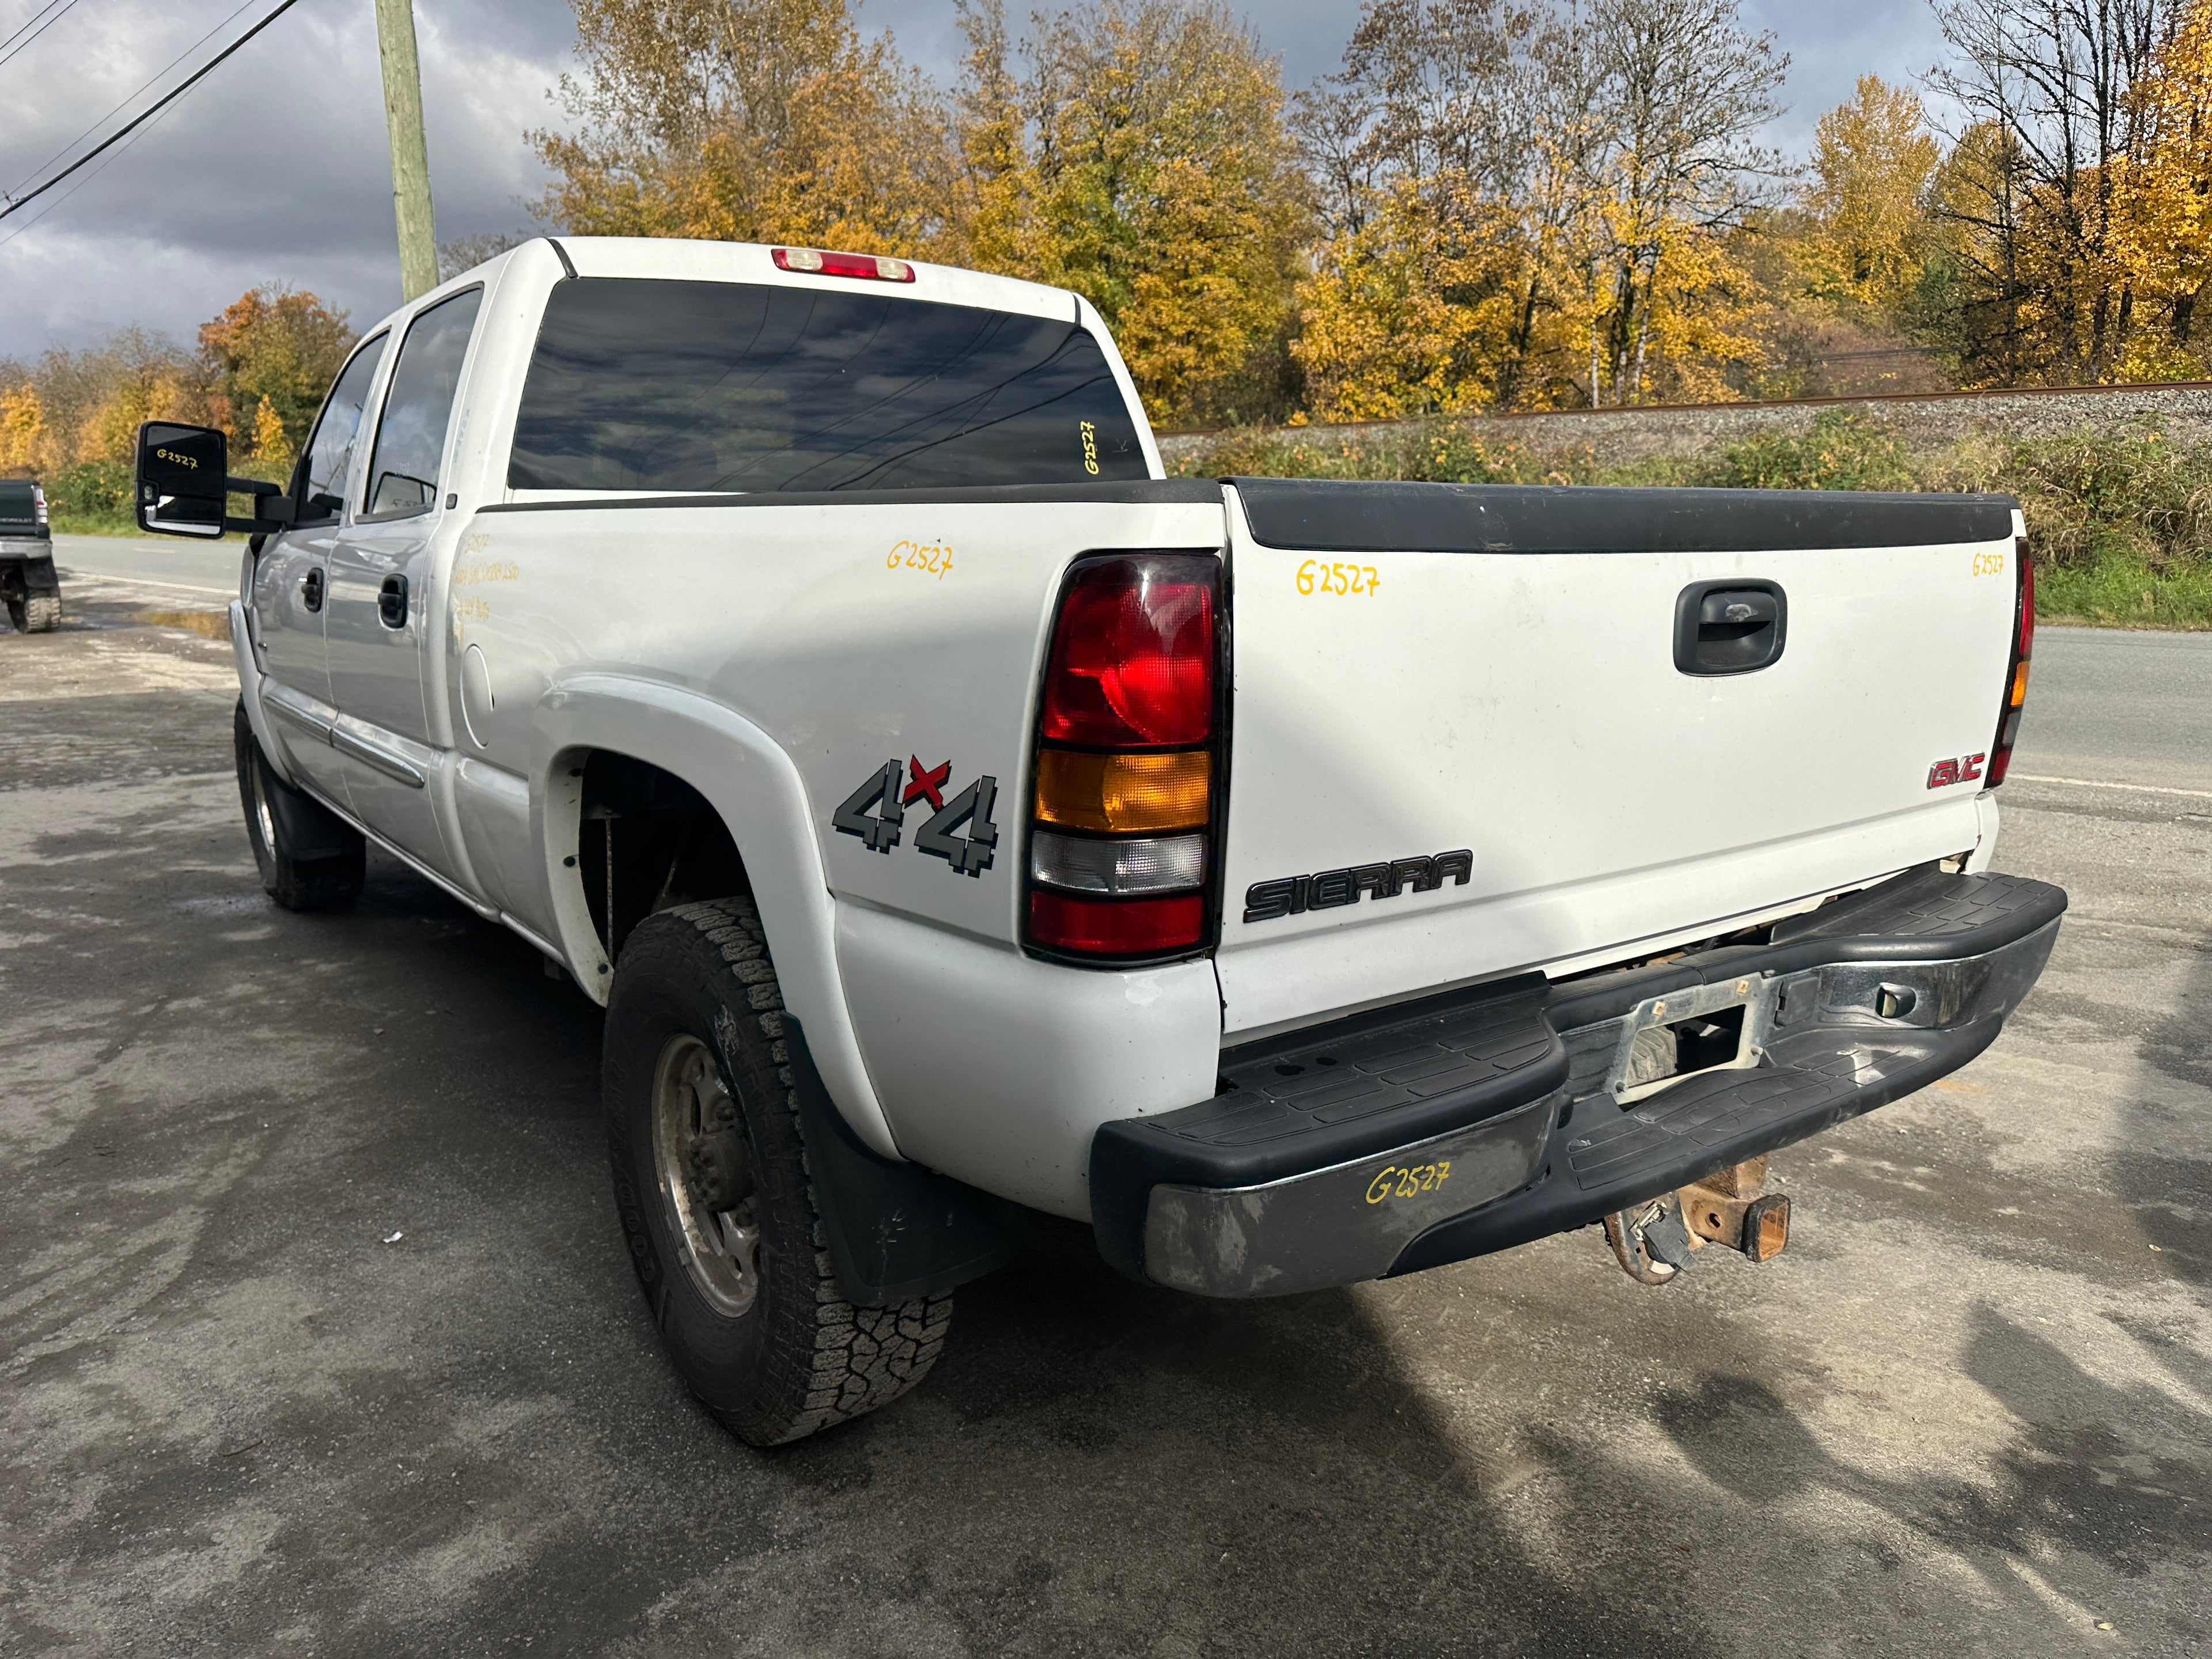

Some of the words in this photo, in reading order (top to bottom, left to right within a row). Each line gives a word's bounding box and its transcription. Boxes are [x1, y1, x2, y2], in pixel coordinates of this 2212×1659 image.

[157, 448, 198, 469] G2527
[1080, 421, 1099, 475] G2527
[887, 540, 953, 580] G2527
[1296, 559, 1381, 597] G2527
[1973, 552, 2003, 577] G2527
[1926, 752, 1985, 790] GMC
[1243, 849, 1474, 923] SIERRA
[1365, 1161, 1451, 1204] G2527
